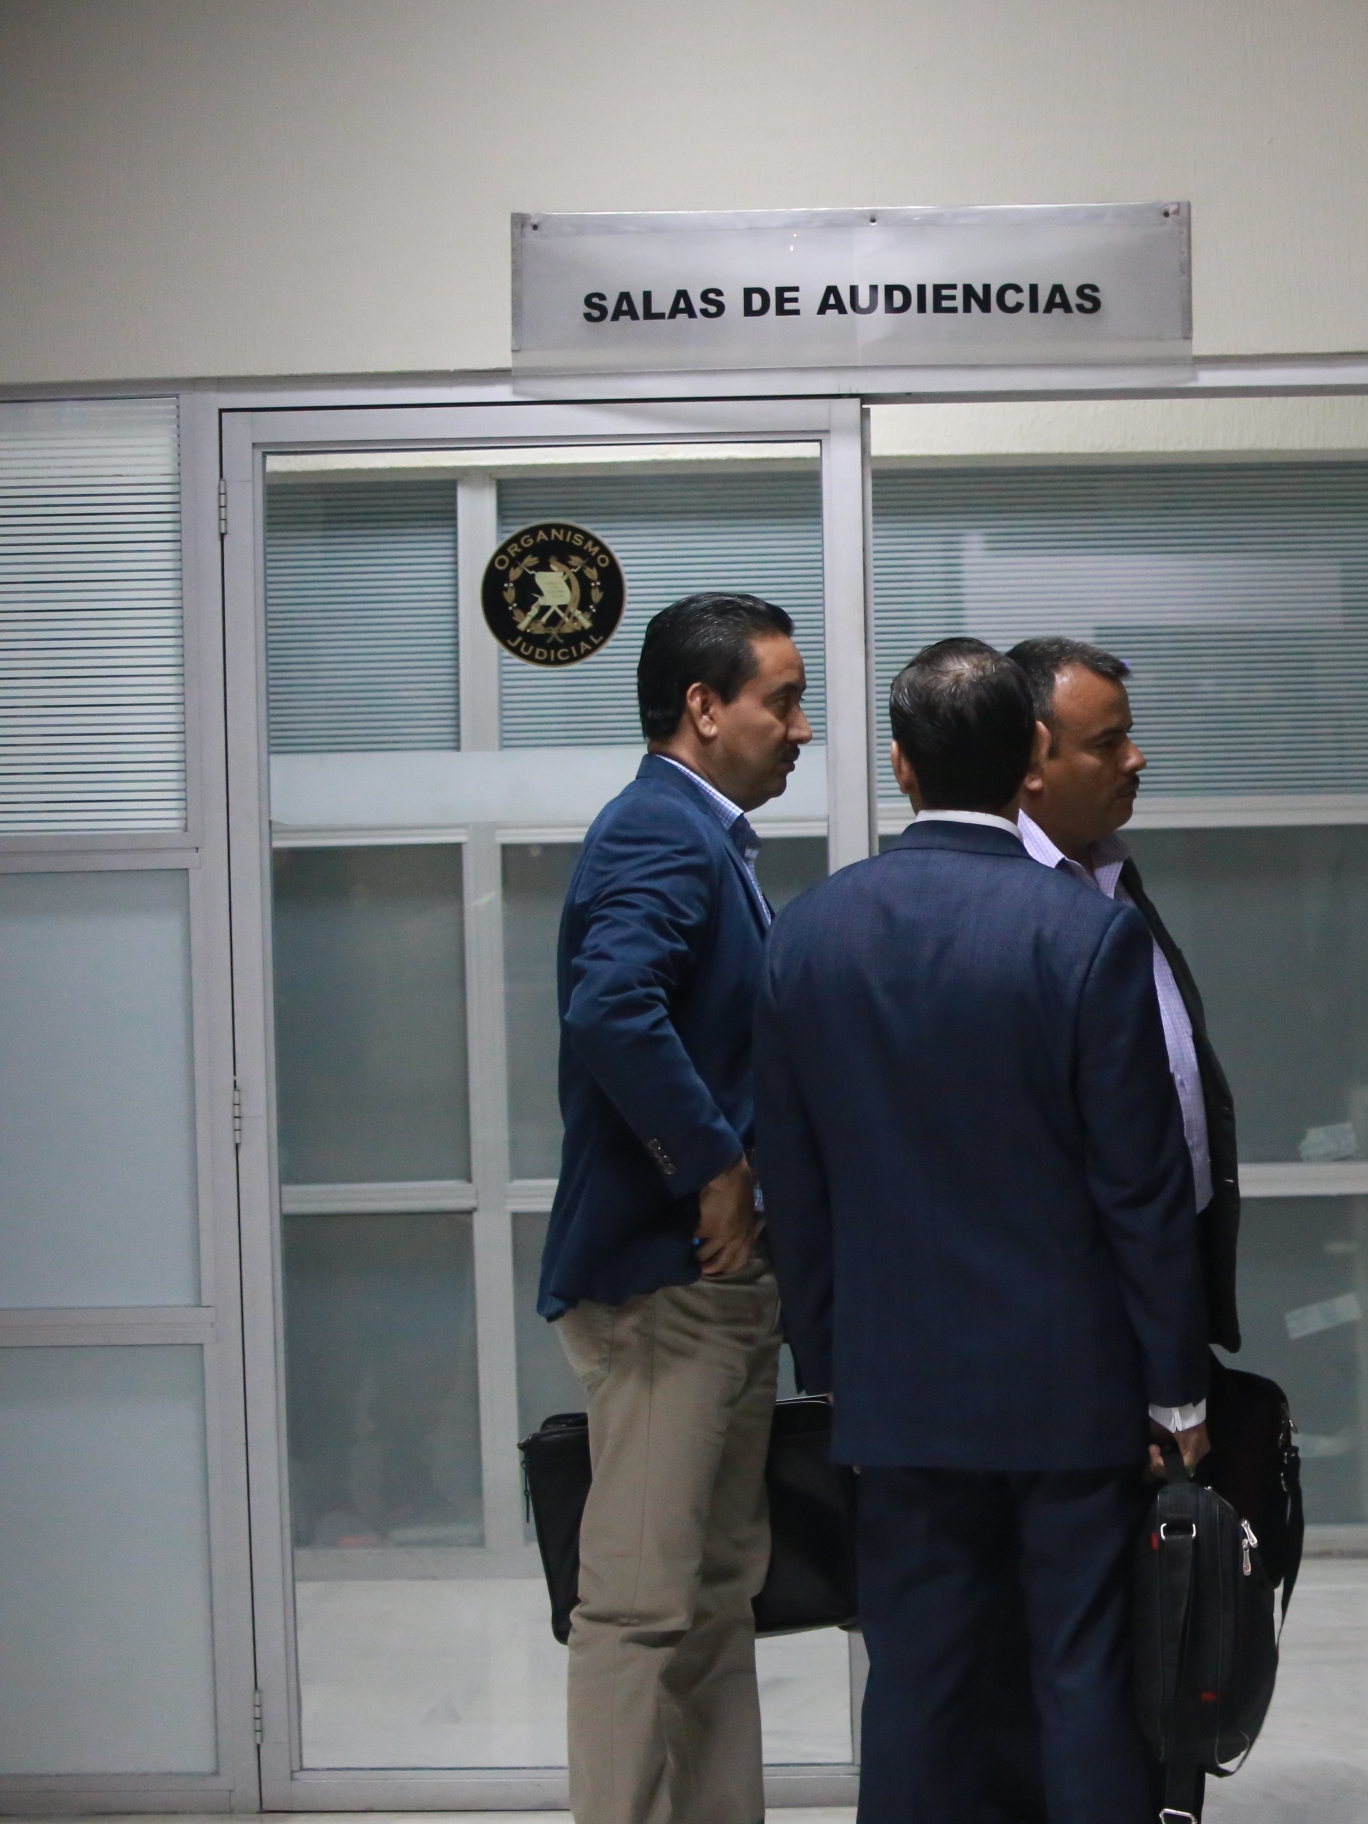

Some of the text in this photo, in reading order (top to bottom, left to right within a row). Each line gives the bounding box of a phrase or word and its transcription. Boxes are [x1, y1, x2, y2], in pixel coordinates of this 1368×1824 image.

[582, 282, 1103, 323] SALAS DE AUDIENCIAS
[495, 529, 610, 570] ORGANISMO
[507, 634, 603, 661] JUDICIAL
